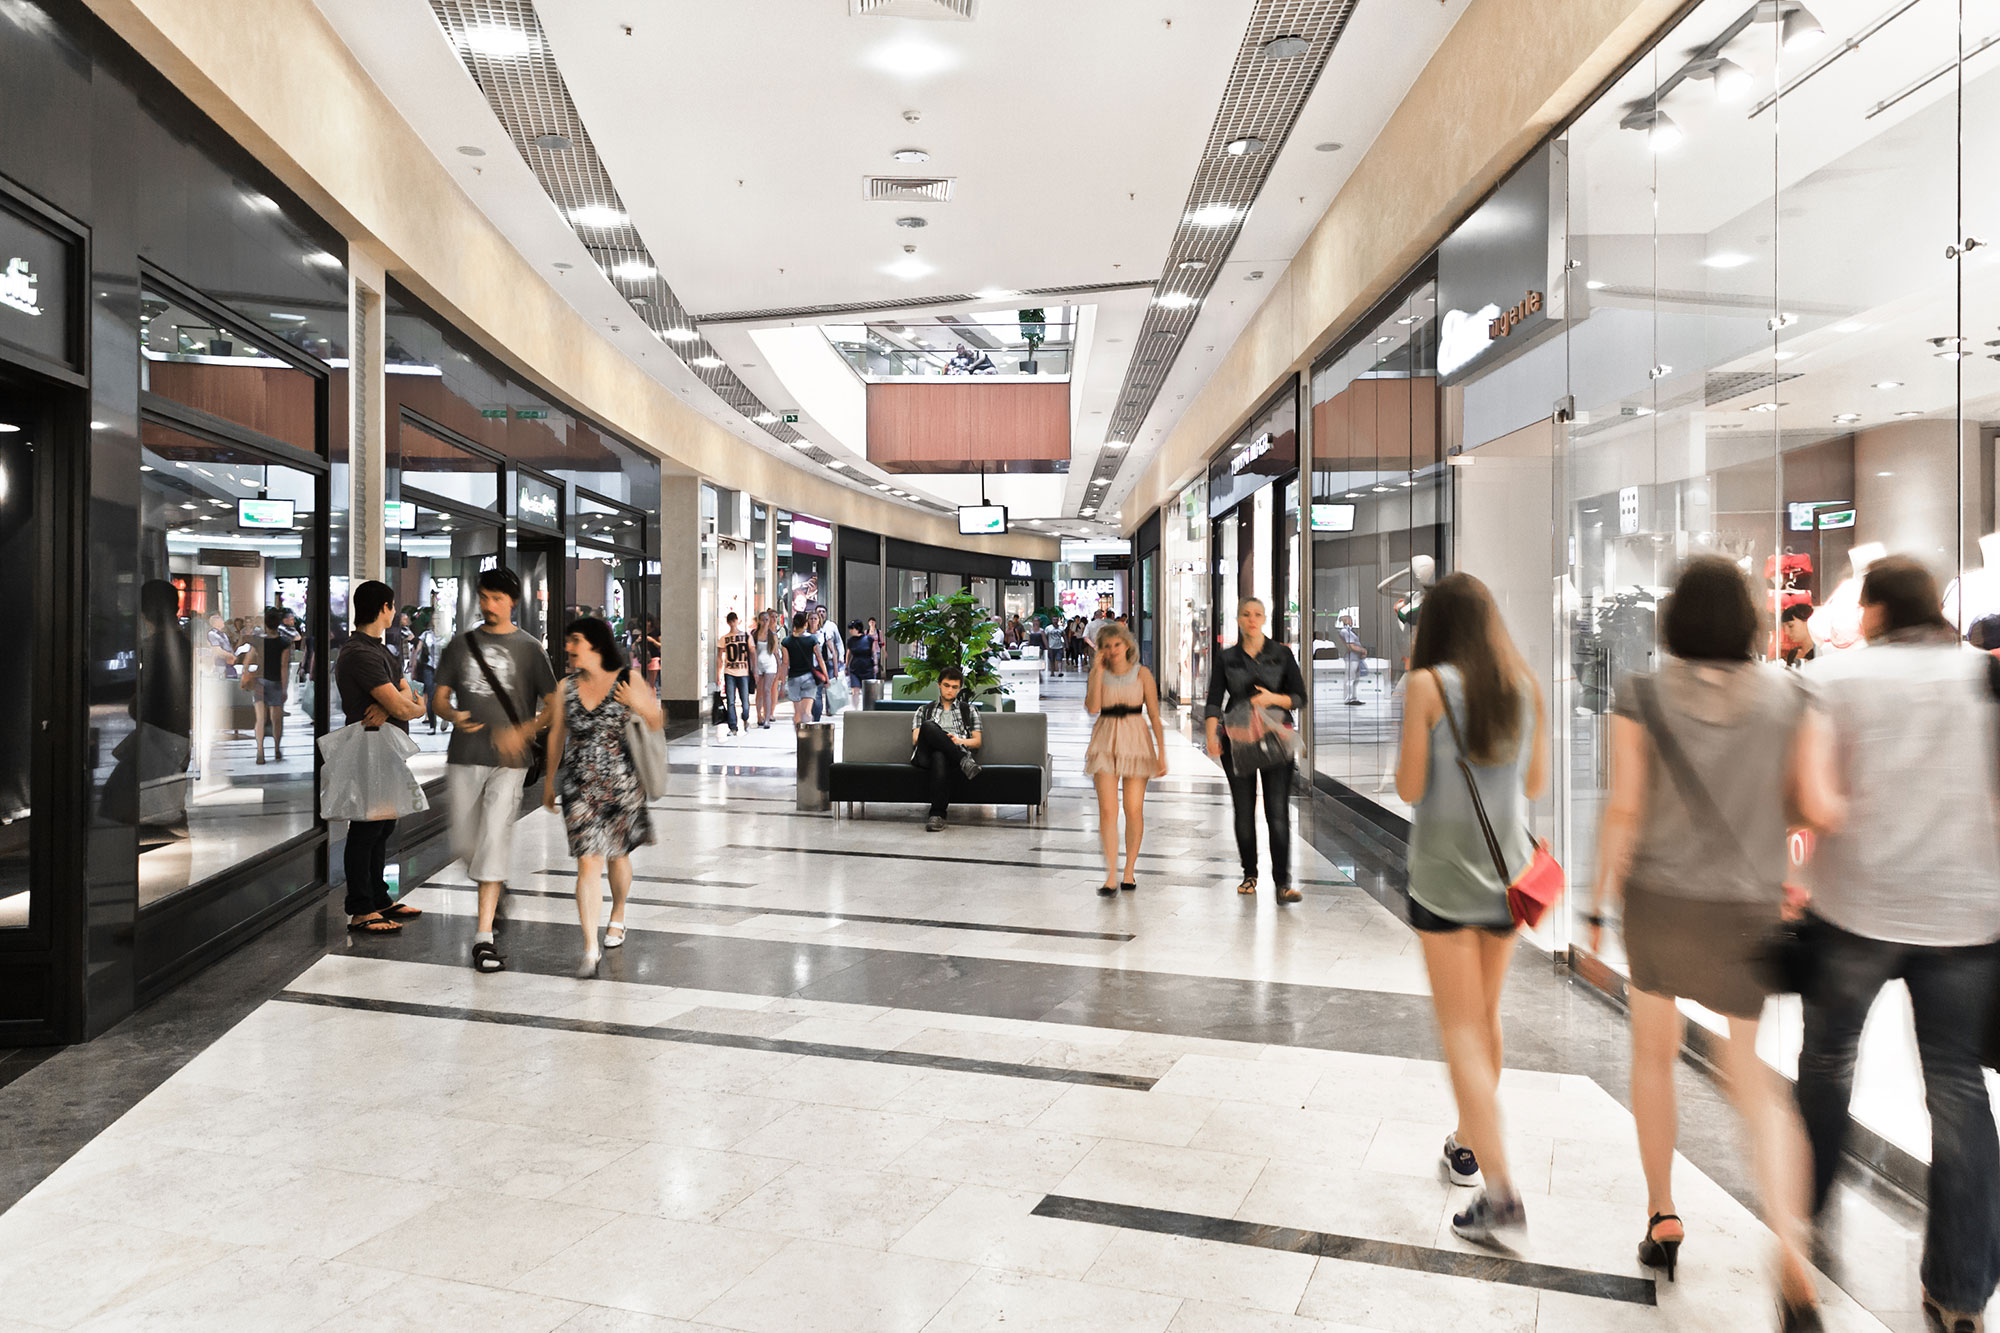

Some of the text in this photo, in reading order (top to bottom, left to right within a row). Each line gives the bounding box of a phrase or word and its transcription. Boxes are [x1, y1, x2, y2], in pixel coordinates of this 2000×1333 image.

[1488, 290, 1543, 340] ingerie
[725, 634, 746, 644] DEAT
[726, 643, 747, 662] OR
